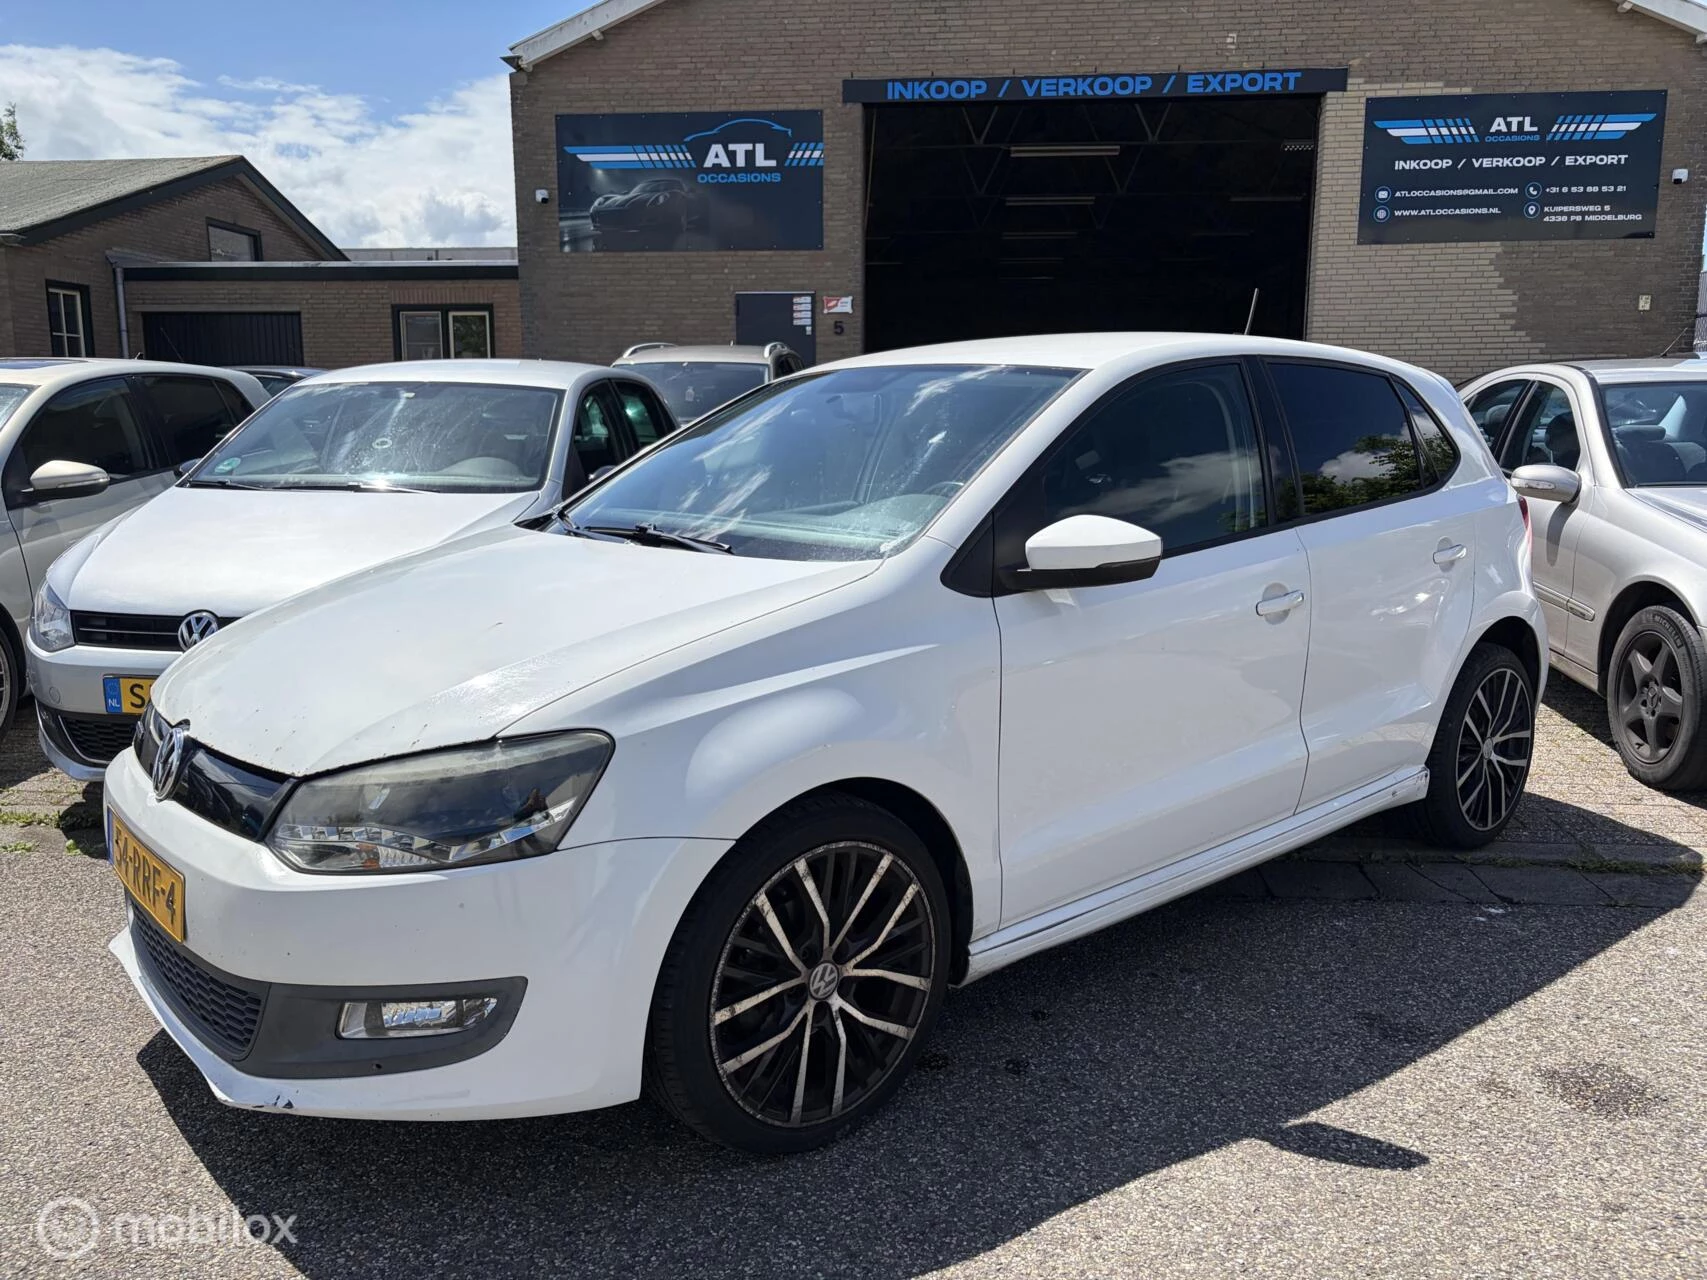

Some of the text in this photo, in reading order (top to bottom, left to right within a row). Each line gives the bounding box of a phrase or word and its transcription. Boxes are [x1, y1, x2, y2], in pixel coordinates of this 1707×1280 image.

[887, 72, 1302, 99] INKOOP / VERKOOP / EXPORT
[1489, 116, 1538, 133] ATL
[1484, 134, 1541, 143] OCCASIONS
[703, 143, 777, 168] ATL
[1395, 159, 1453, 170] INKOOP
[1472, 156, 1546, 168] VERKOOP
[1565, 154, 1628, 166] EXPORT
[697, 172, 781, 184] OCCASIONS
[1394, 187, 1519, 198] ATLOCCASIONS@GMAIL.COM
[1394, 207, 1502, 216] WWW.ATLOCCASIONS.NL
[1584, 213, 1642, 221] MIDDELBURG
[834, 321, 845, 335] 5
[108, 698, 121, 707] NL
